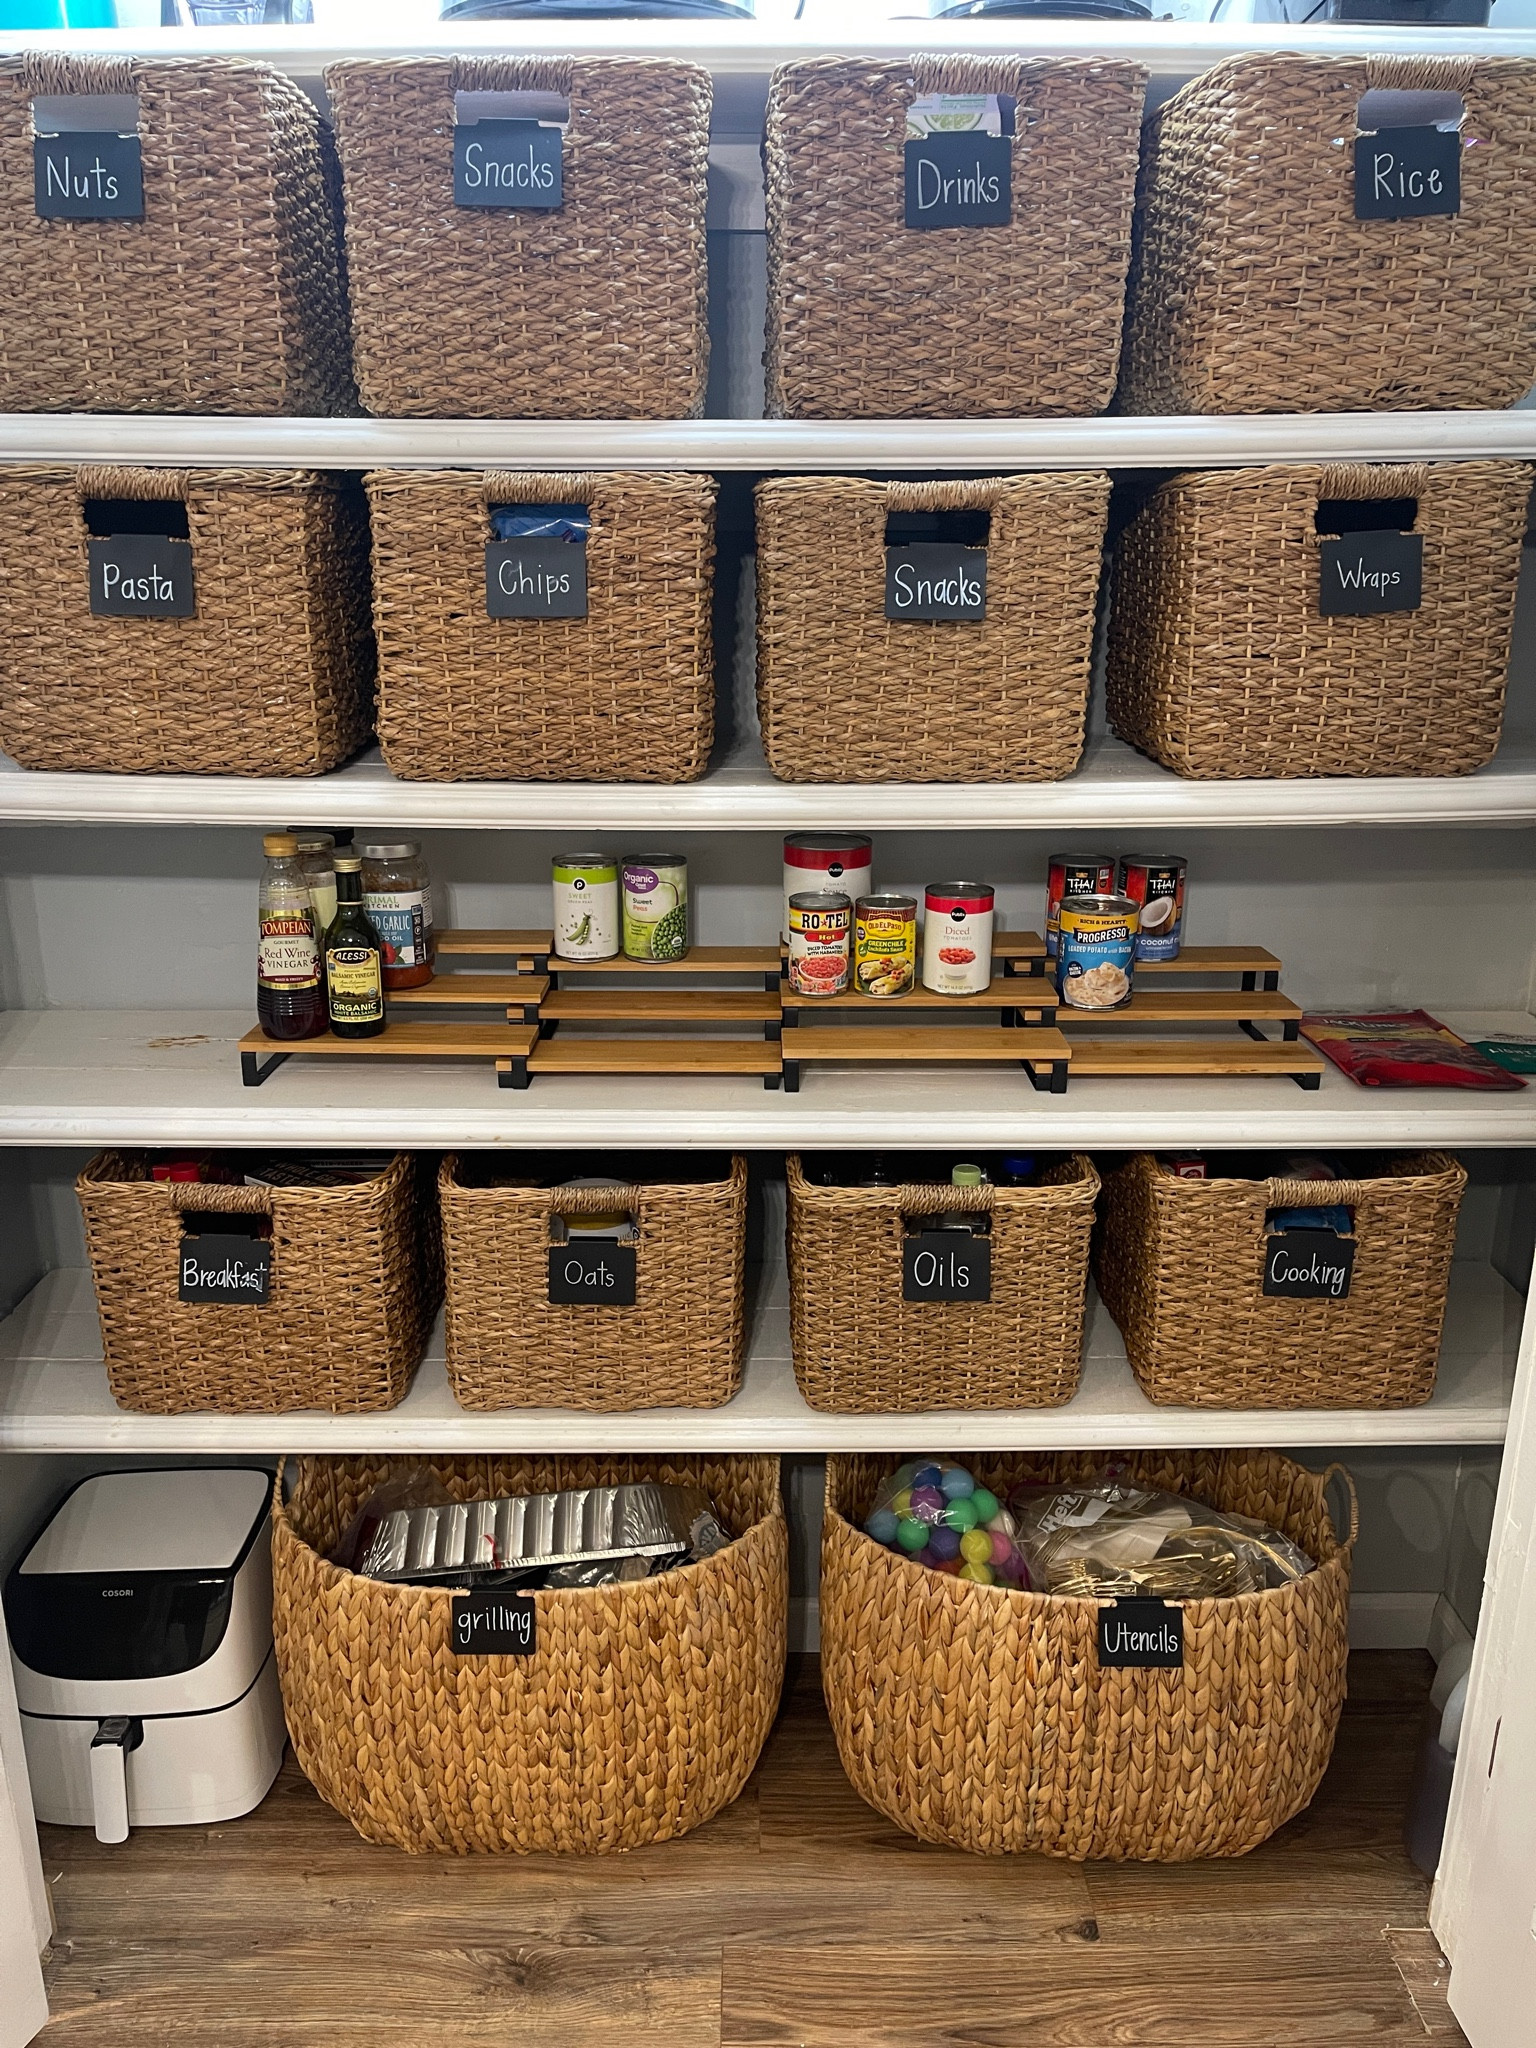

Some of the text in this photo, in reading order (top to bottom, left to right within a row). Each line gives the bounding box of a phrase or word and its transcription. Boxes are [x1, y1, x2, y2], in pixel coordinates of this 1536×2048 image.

[46, 156, 119, 200] Nuts
[465, 143, 554, 190] Snacks
[1373, 152, 1444, 201] Rice
[917, 159, 999, 209] Drinks
[103, 564, 175, 602] Pasta
[498, 559, 571, 604] Chips
[894, 565, 982, 607] Snacks
[1337, 558, 1401, 599] Wraps
[624, 872, 654, 885] Organic
[1067, 878, 1094, 890] THAI
[1150, 880, 1176, 890] THAI
[262, 922, 312, 936] POMPEIAN
[382, 915, 410, 930] GARLIC
[945, 926, 970, 935] Diced
[1077, 928, 1127, 943] PROGRESSO
[264, 948, 311, 959] Red Wine
[336, 952, 368, 960] ALESSI
[1141, 938, 1174, 946] coconut
[266, 960, 308, 968] VINEGAR
[333, 1002, 377, 1011] ORGANIC
[260, 1168, 300, 1184] TASTE
[183, 1258, 267, 1293] Breakfast
[564, 1260, 615, 1288] Oats
[914, 1251, 970, 1288] Oils
[1270, 1250, 1346, 1296] Cooking
[1042, 1495, 1078, 1532] Heft
[102, 1589, 134, 1598] COSORI
[457, 1606, 532, 1644] grilling
[1104, 1622, 1178, 1654] Utencils
